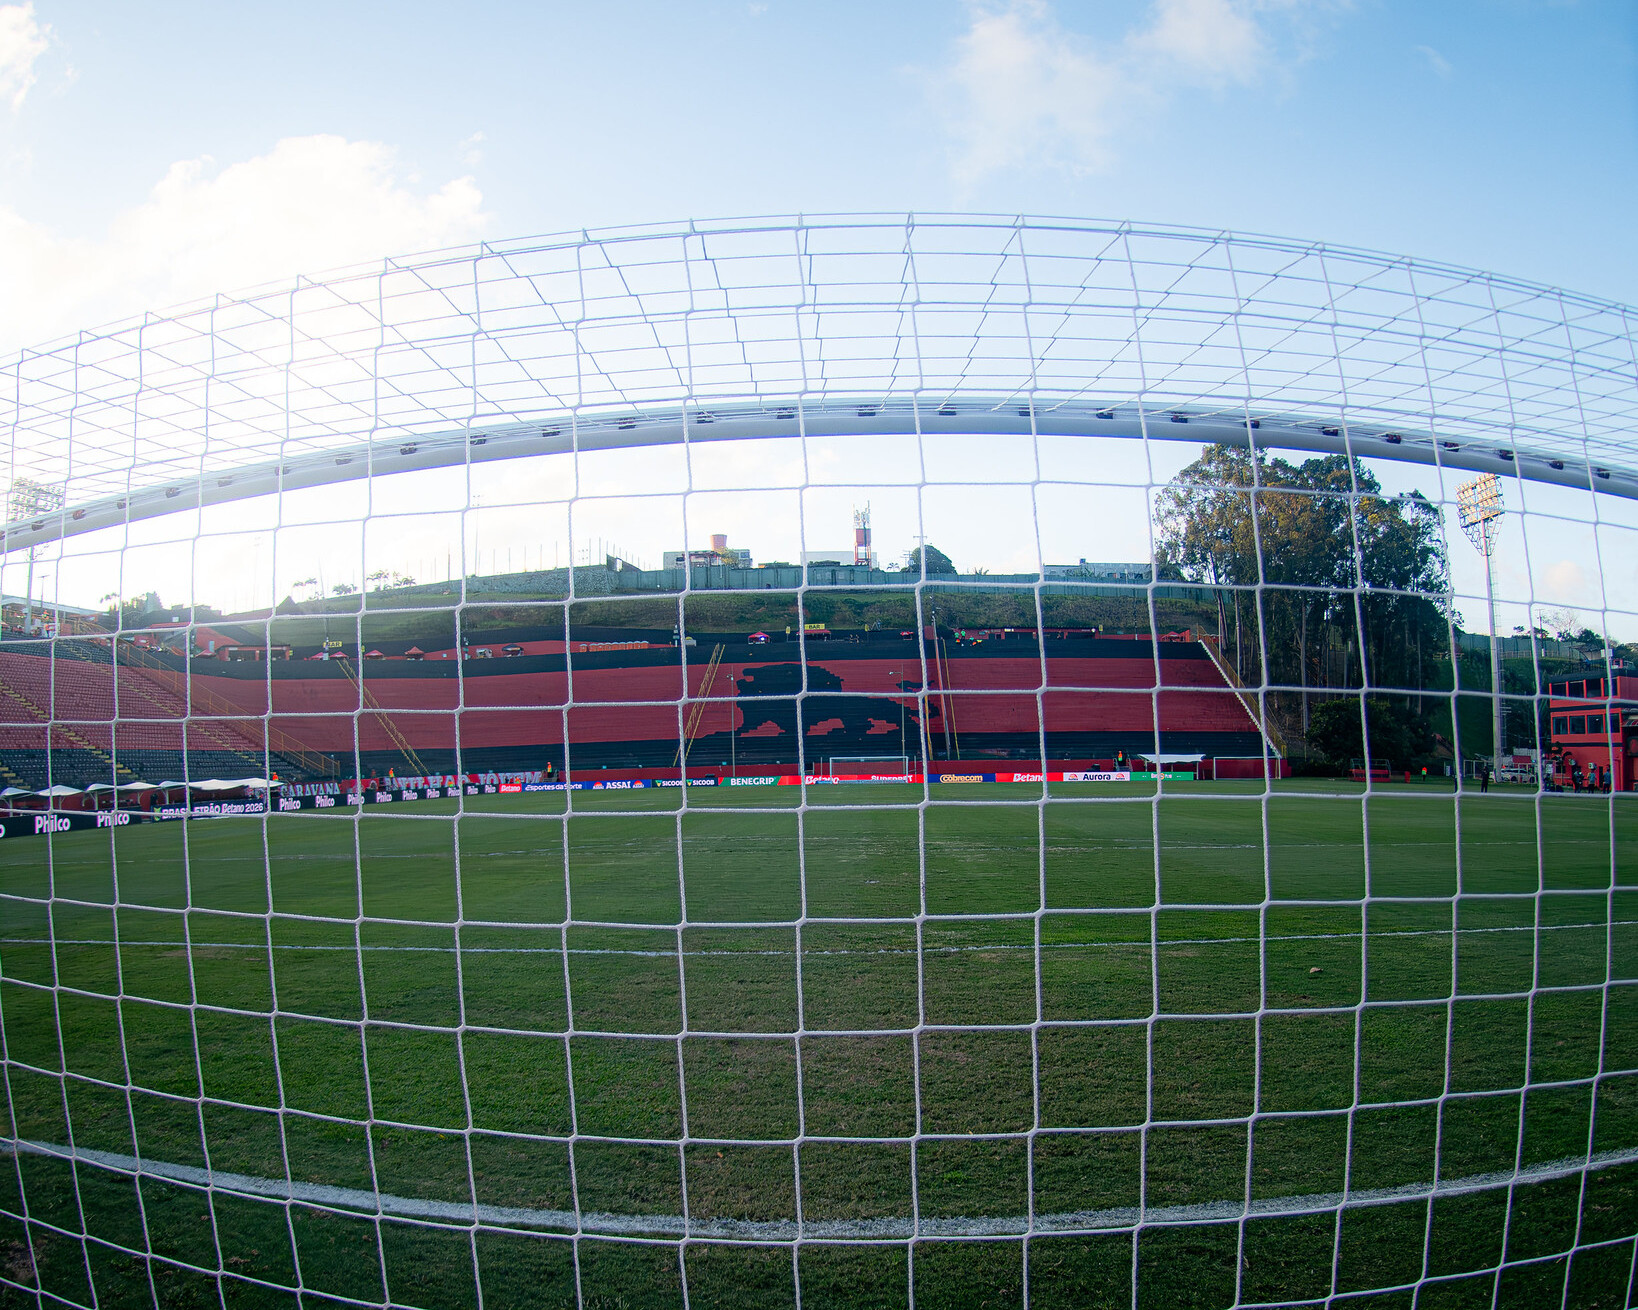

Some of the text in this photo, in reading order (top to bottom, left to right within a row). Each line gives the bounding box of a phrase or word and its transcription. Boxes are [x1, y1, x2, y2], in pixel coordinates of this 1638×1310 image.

[730, 777, 774, 786] BENEGRIP
[1082, 773, 1111, 781] Aurora
[280, 782, 341, 797] CARAVANA
[525, 784, 555, 792] Esportes
[606, 781, 631, 790] ASSAÍ
[280, 797, 301, 811] Philco
[315, 795, 335, 808] Philco
[376, 791, 392, 803] Philco
[402, 789, 418, 801] Philco
[426, 788, 440, 799] Philco
[221, 803, 244, 813] Betano
[245, 802, 263, 812] 2026
[35, 814, 71, 834] Philco
